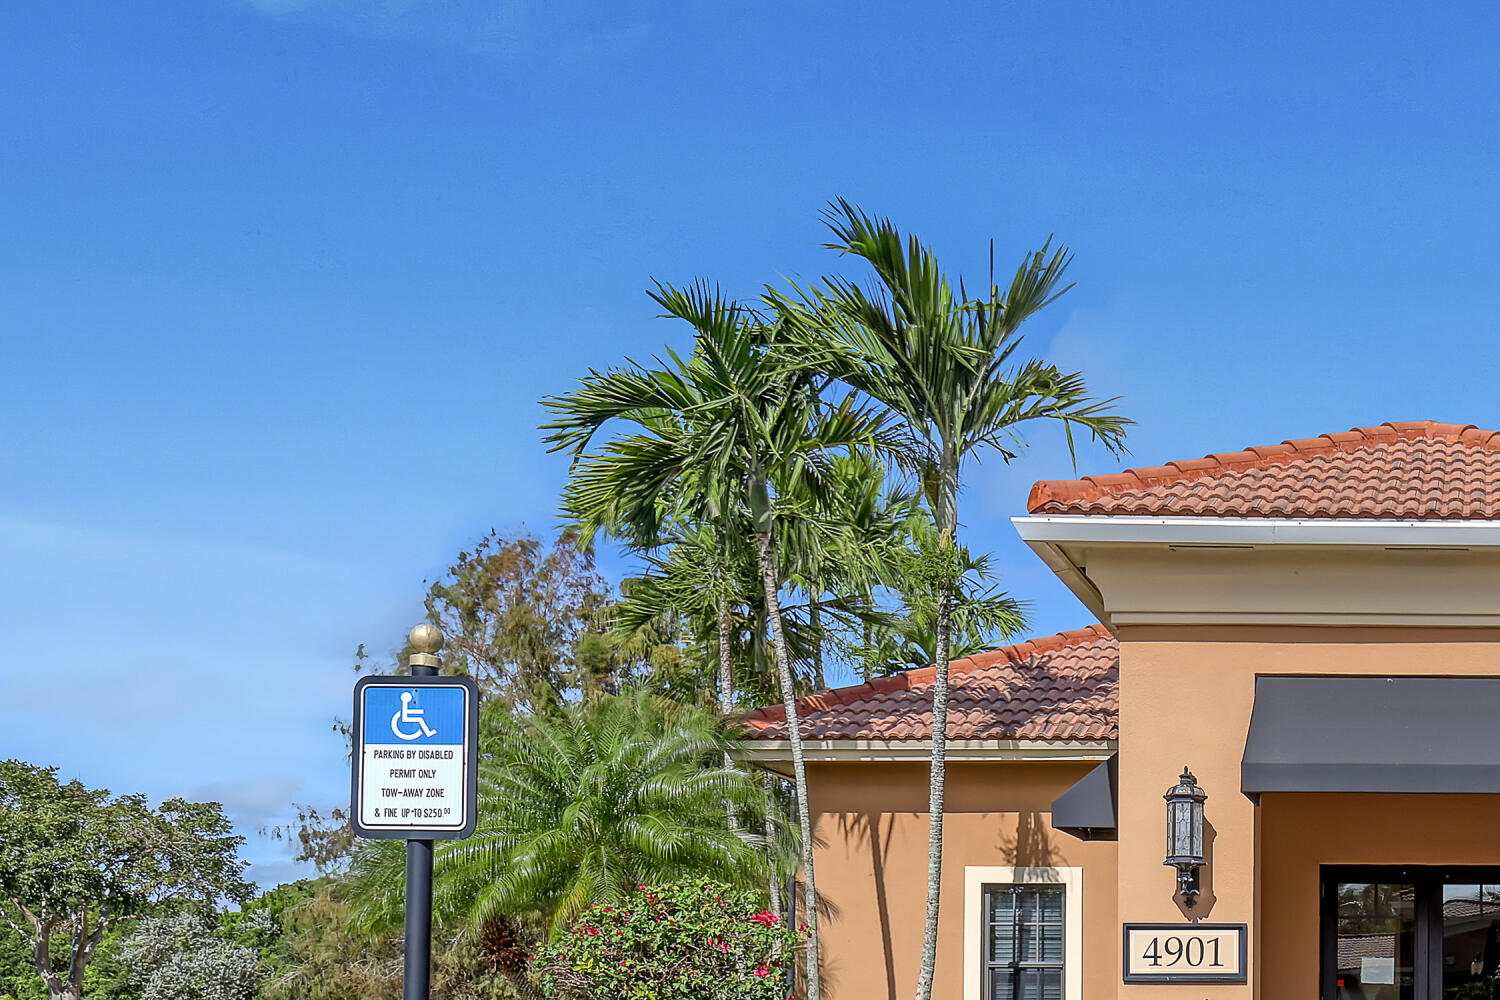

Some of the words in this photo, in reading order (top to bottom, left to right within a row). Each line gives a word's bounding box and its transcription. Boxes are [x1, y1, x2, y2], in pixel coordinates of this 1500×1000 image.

[373, 749, 405, 759] PARKING
[406, 750, 417, 760] BY
[418, 750, 454, 760] DISABLED
[389, 769, 416, 779] PERMIT
[418, 769, 437, 779] ONLY
[381, 787, 424, 798] TOW-AWAY
[425, 788, 445, 798] ZONE
[374, 807, 381, 818] &
[384, 807, 398, 818] FINE
[1142, 936, 1225, 967] 4901
